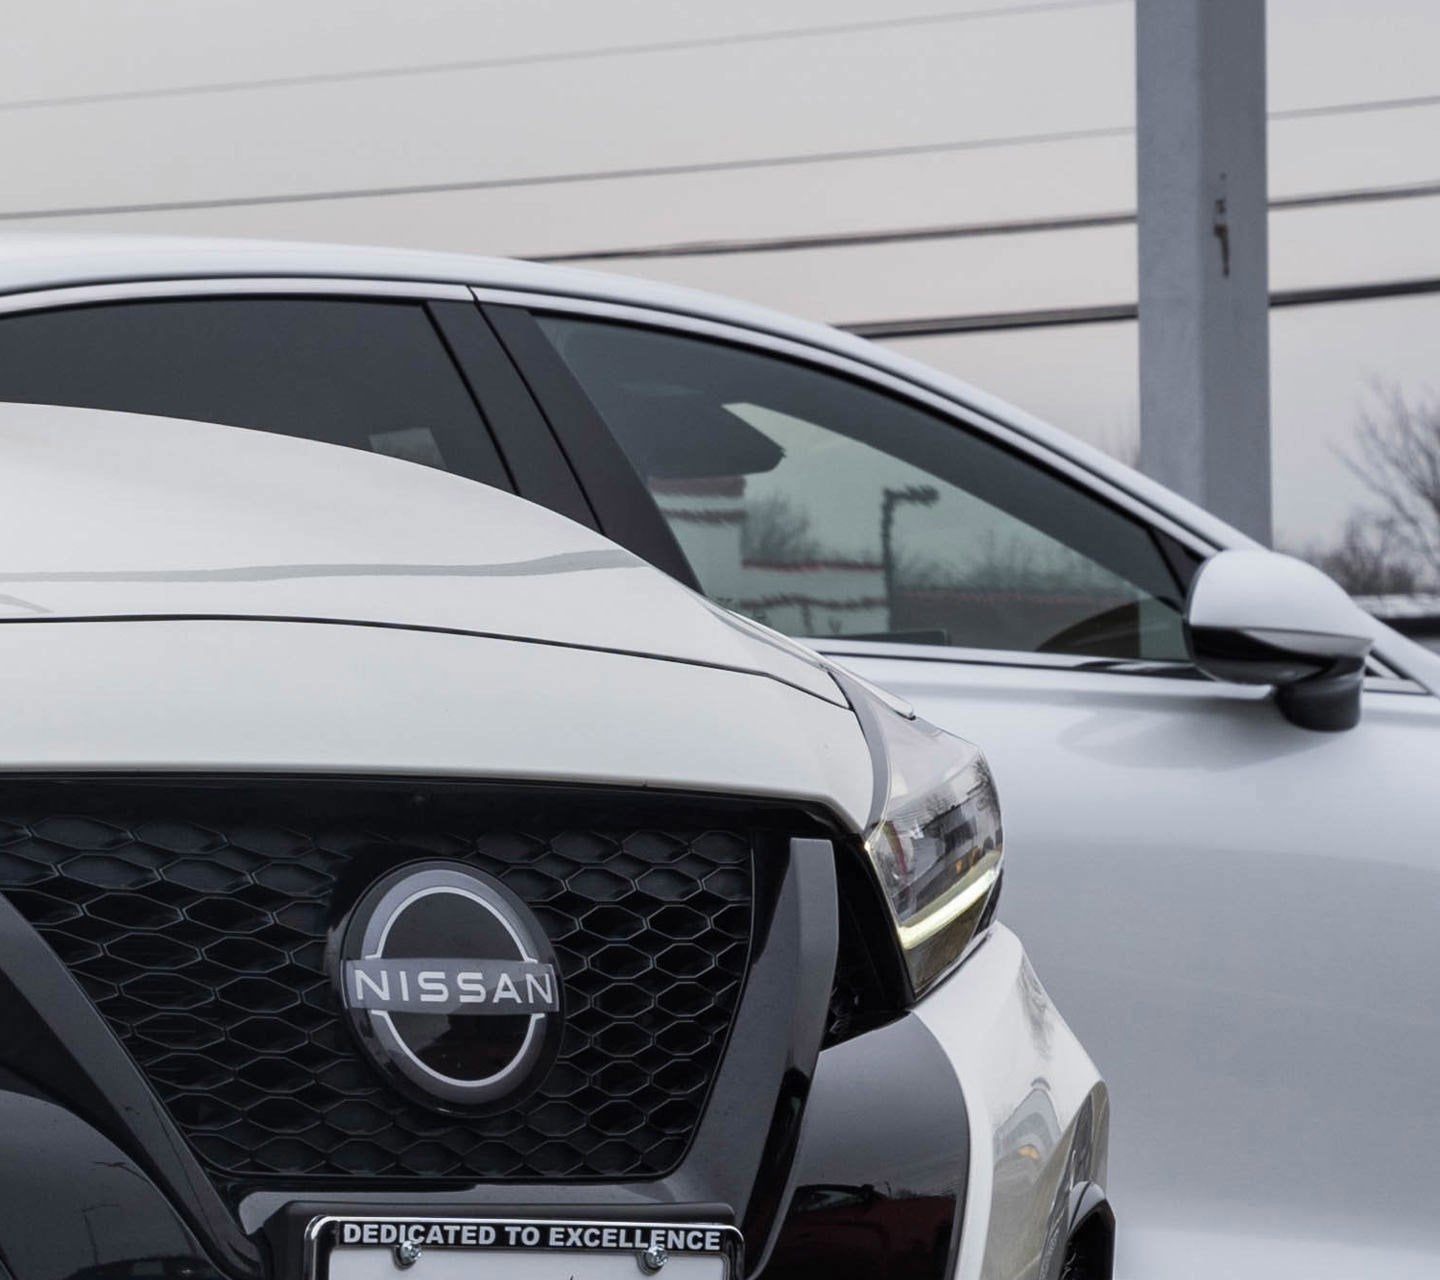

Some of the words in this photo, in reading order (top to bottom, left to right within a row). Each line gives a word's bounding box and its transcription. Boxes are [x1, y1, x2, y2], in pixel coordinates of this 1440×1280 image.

[354, 969, 553, 1004] NISSAN
[343, 1223, 496, 1244] DEDICATED
[505, 1226, 540, 1245] TO
[549, 1227, 721, 1250] EXCELLENCE
